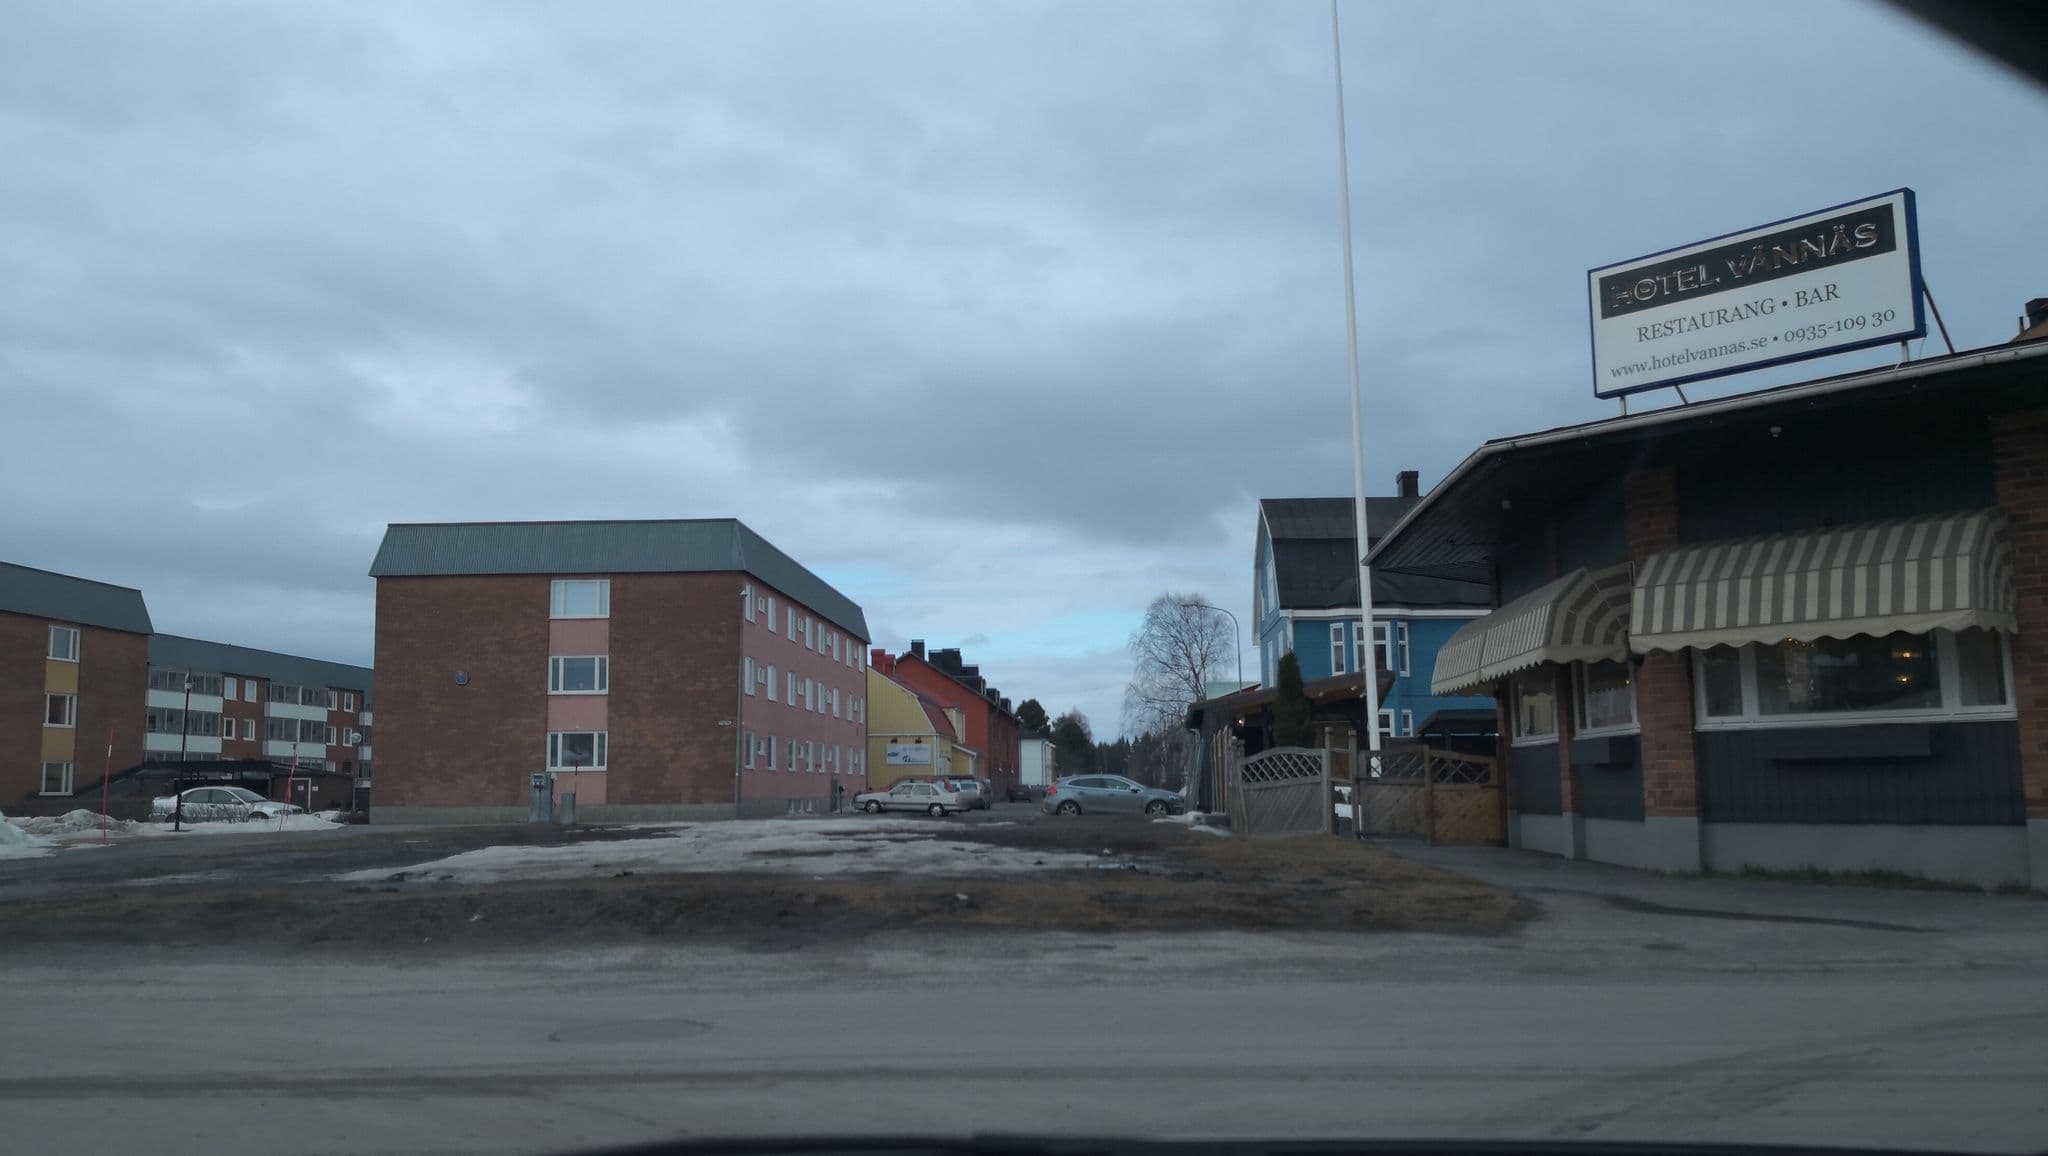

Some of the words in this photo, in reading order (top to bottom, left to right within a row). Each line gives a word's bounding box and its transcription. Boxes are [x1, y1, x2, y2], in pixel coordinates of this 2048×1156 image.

[1610, 264, 1720, 308] HOTEL
[1725, 223, 1879, 279] VÄNNÄS
[1610, 335, 1768, 378] www.hotelvannas.se
[1784, 315, 1867, 343] 0935-109
[1872, 309, 1895, 328] 30
[1636, 297, 1776, 343] RESTAURANG
[1794, 283, 1840, 308] BAR
